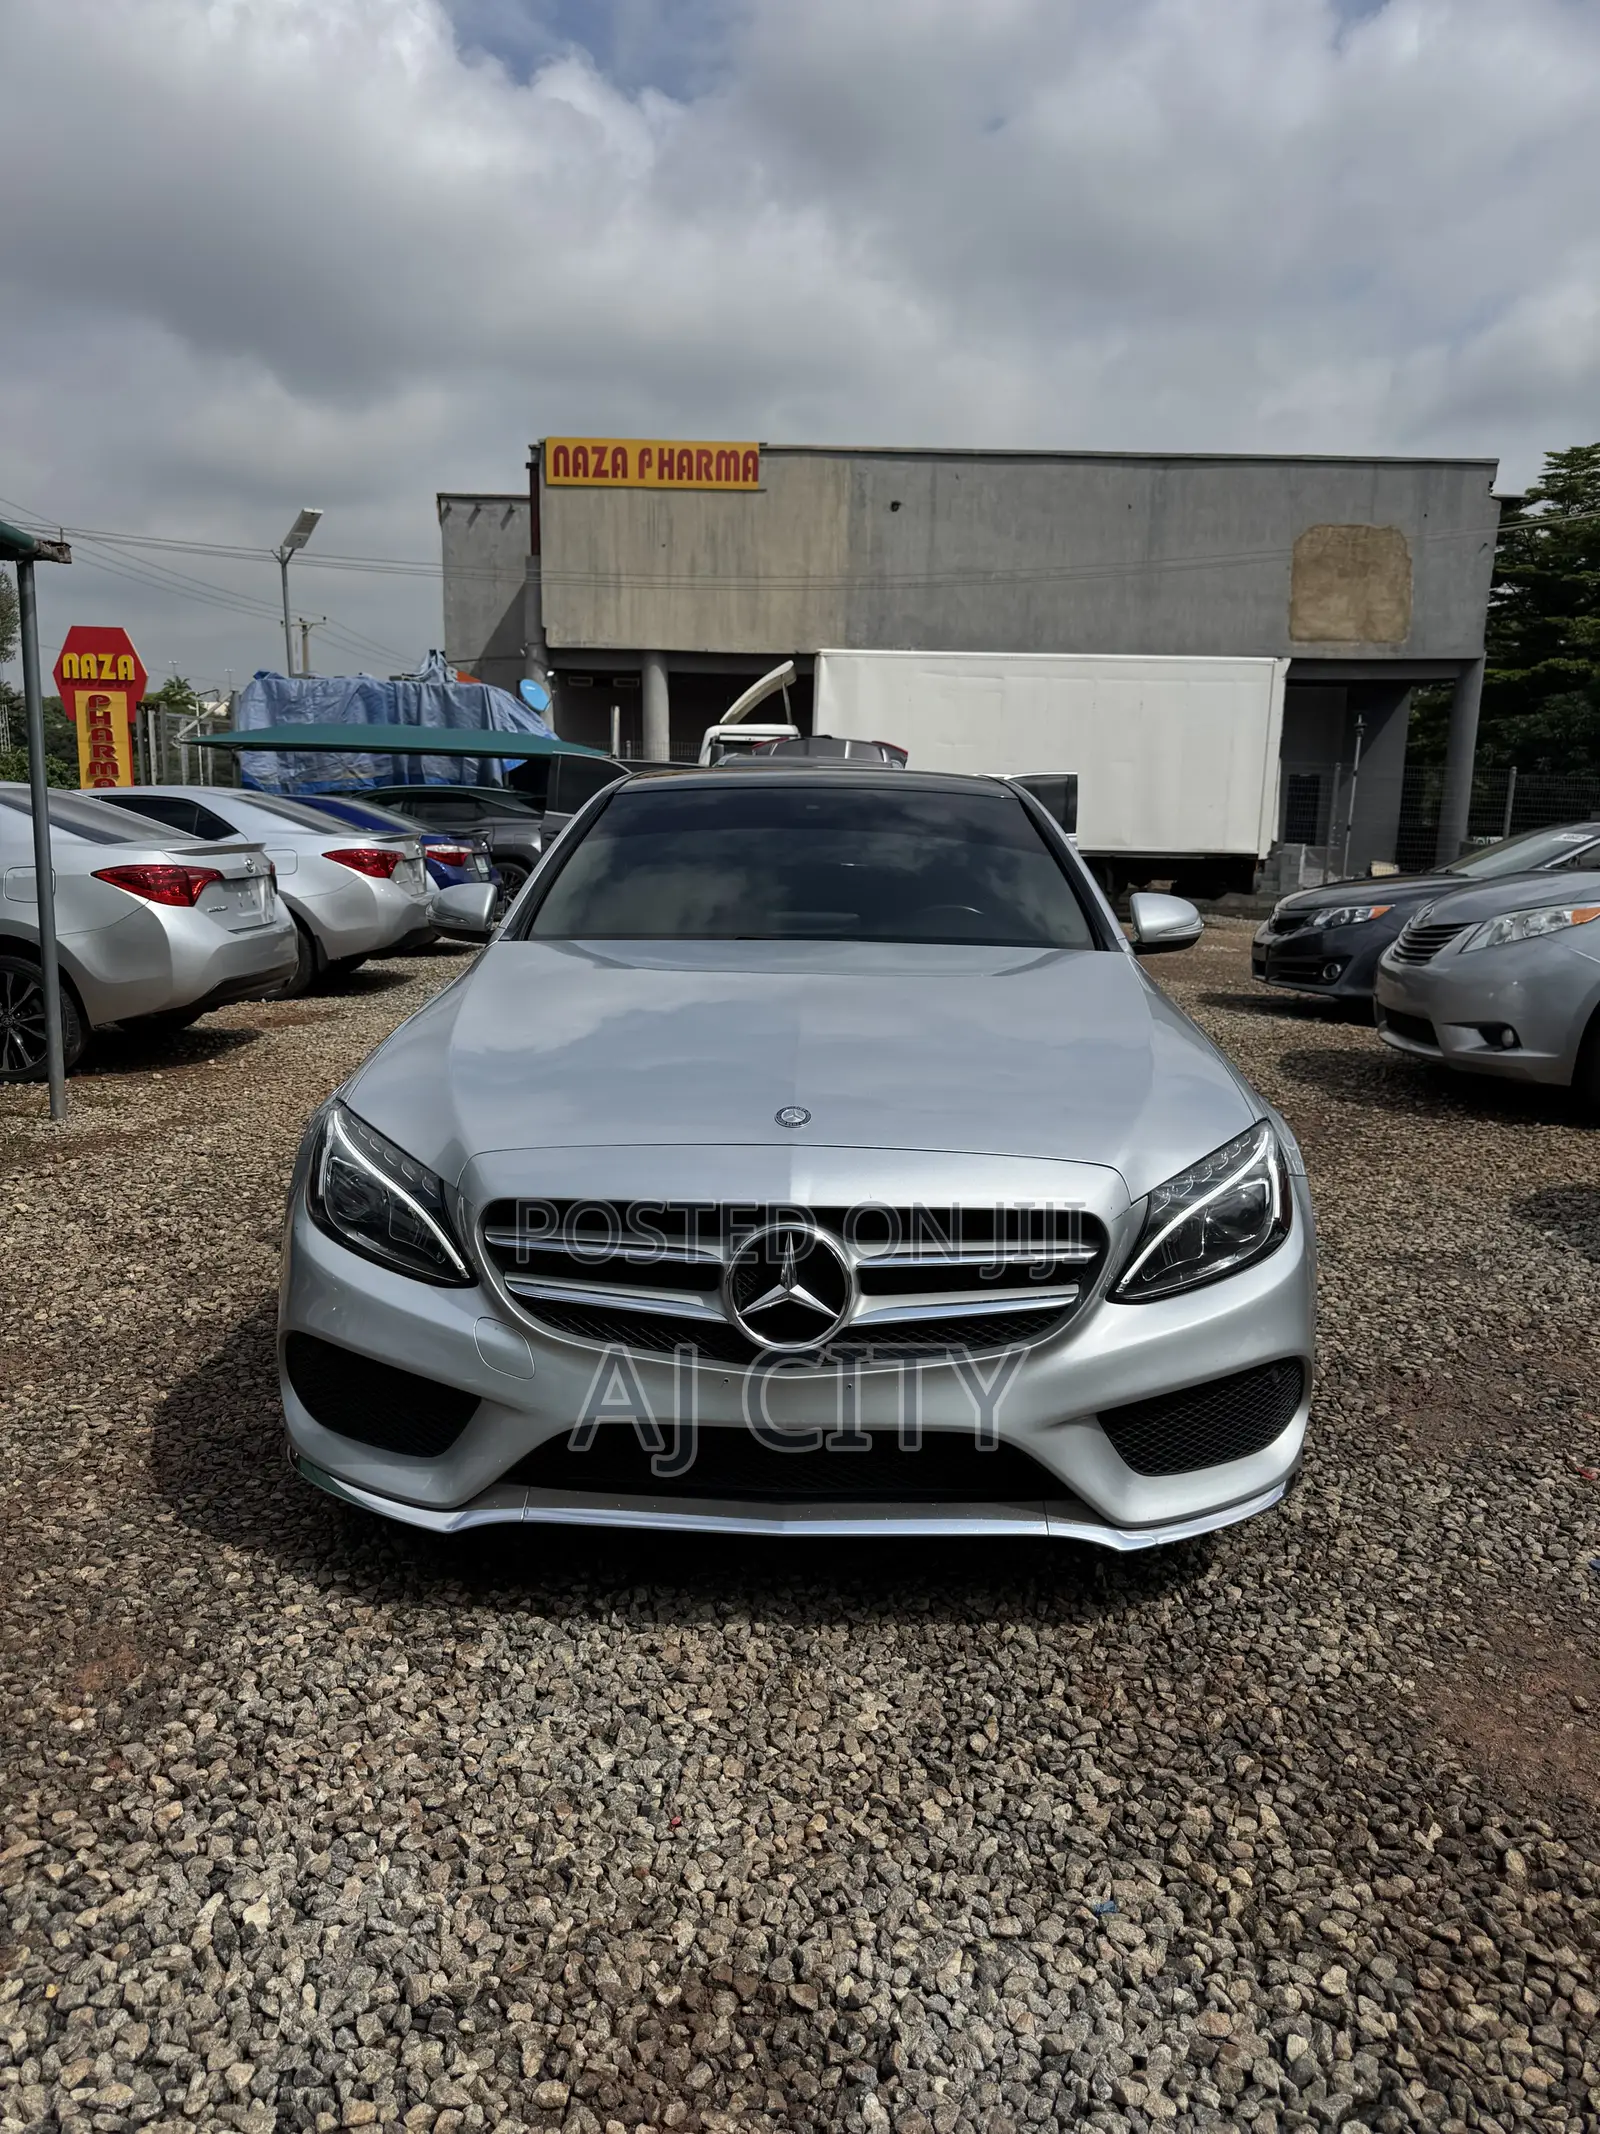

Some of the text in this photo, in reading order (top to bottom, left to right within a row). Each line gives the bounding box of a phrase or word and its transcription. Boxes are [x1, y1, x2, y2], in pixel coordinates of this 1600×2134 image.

[553, 445, 759, 482] NAZA PHARMA
[62, 653, 135, 681] NAZA
